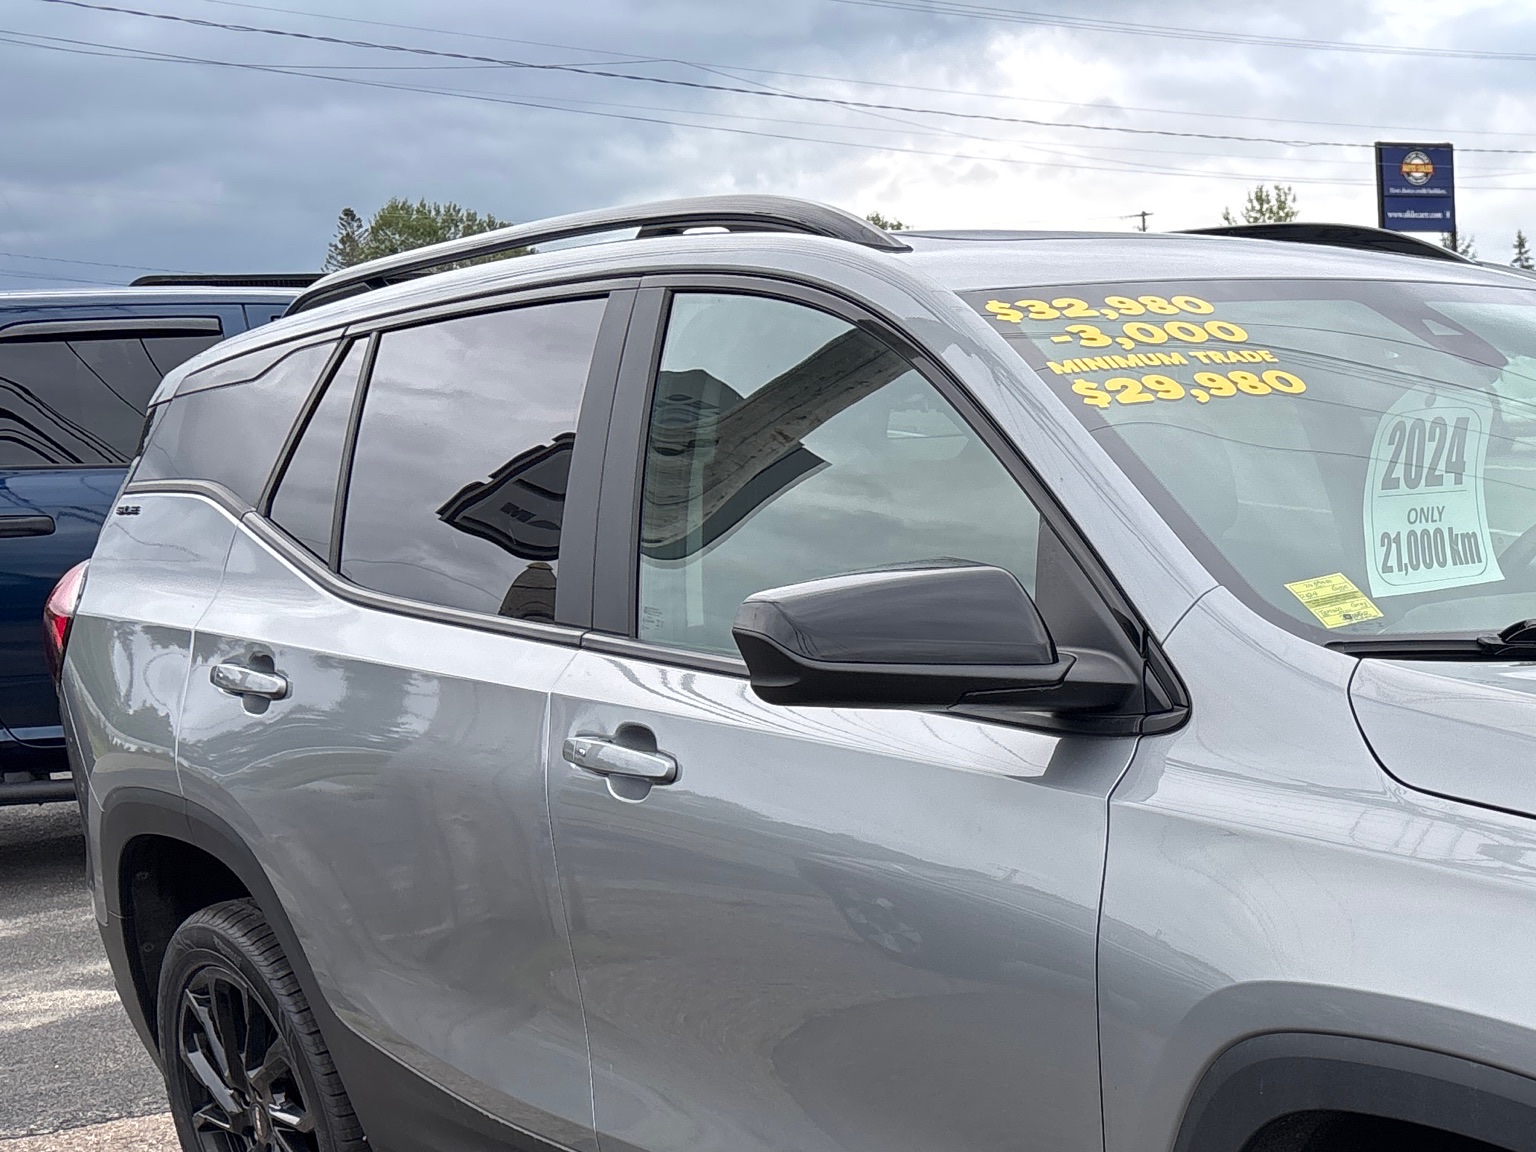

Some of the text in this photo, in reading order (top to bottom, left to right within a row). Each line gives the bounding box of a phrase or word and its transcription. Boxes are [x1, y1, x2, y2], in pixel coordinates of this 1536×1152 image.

[985, 295, 1214, 323] $32,980
[1051, 320, 1249, 350] -3,000
[1046, 350, 1280, 375] MINIMUM TRADE
[1072, 370, 1306, 408] $29,980
[1381, 416, 1470, 490] 2024
[1407, 506, 1446, 524] ONLY
[1380, 526, 1483, 576] 21,000 km
